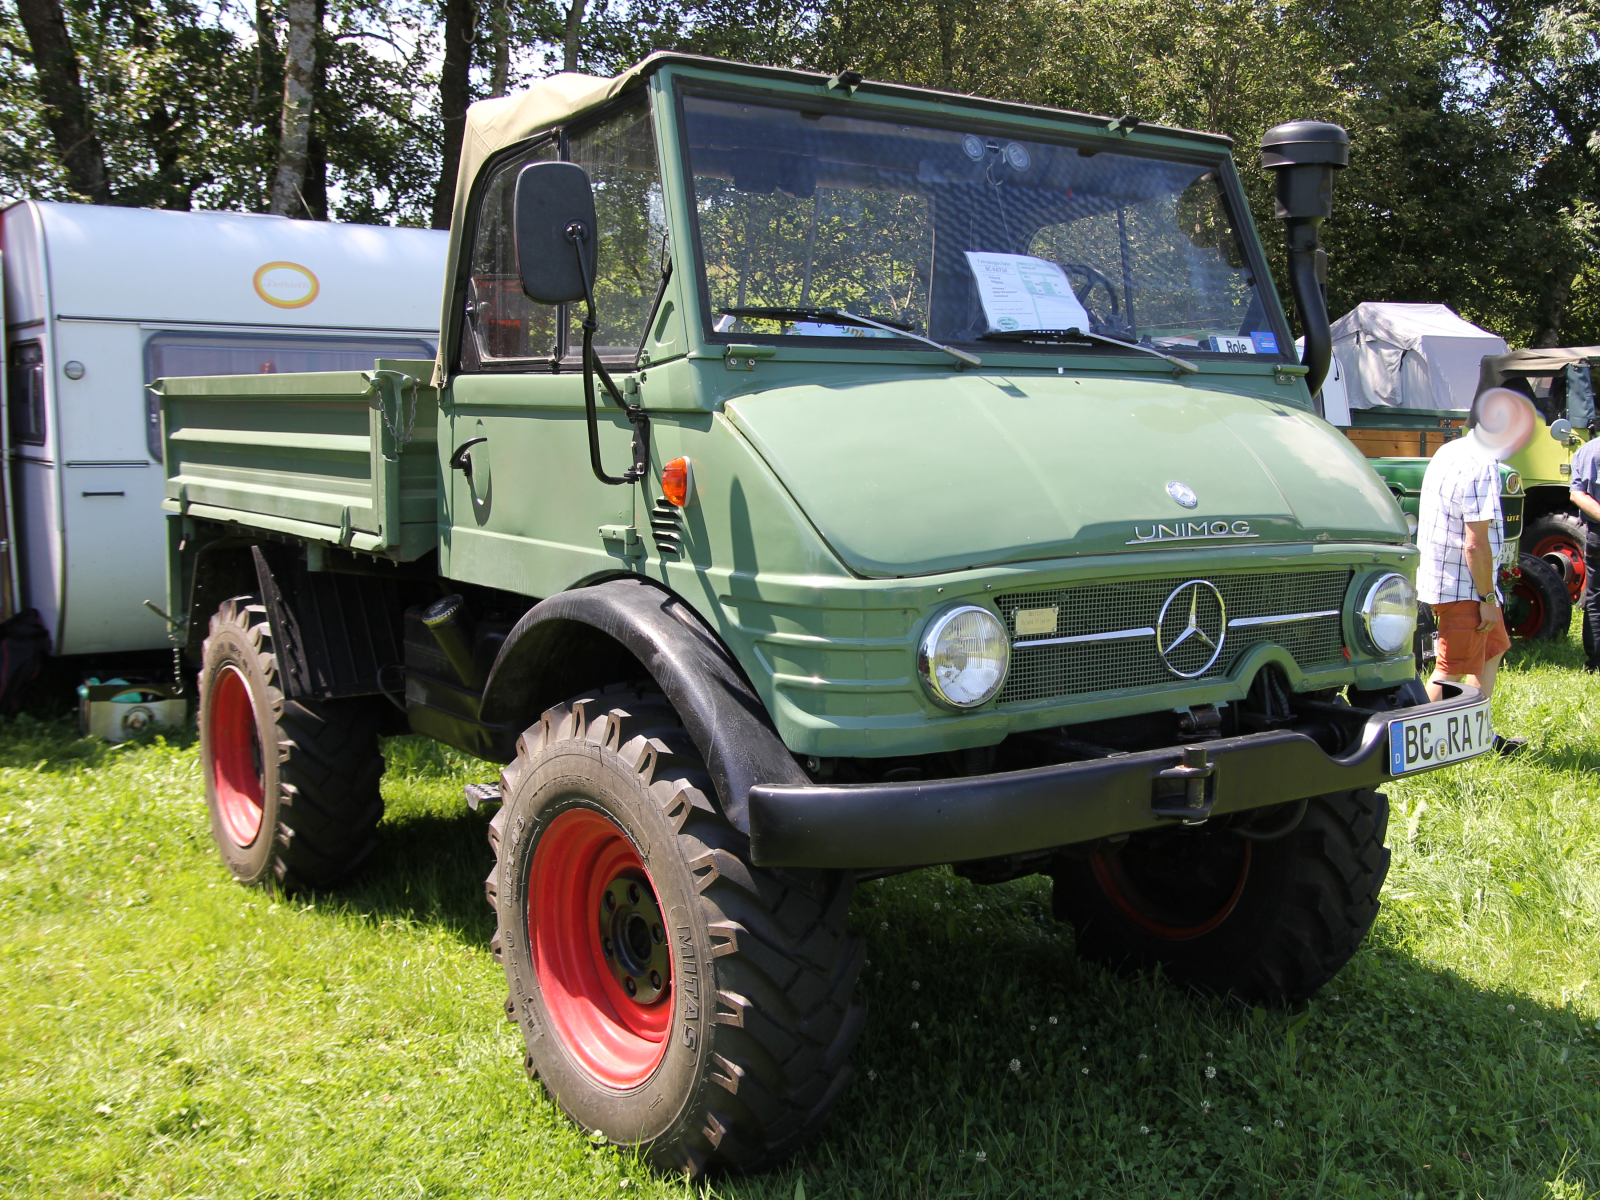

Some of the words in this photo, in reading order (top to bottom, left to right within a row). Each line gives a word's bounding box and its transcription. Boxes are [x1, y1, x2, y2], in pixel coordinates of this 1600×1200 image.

[1226, 340, 1247, 353] Role
[1135, 520, 1250, 540] UNIMOG
[1395, 753, 1401, 764] D
[1405, 722, 1433, 764] BC
[1447, 714, 1473, 755] RA
[1476, 709, 1493, 747] 71
[677, 925, 700, 1051] MITAS
